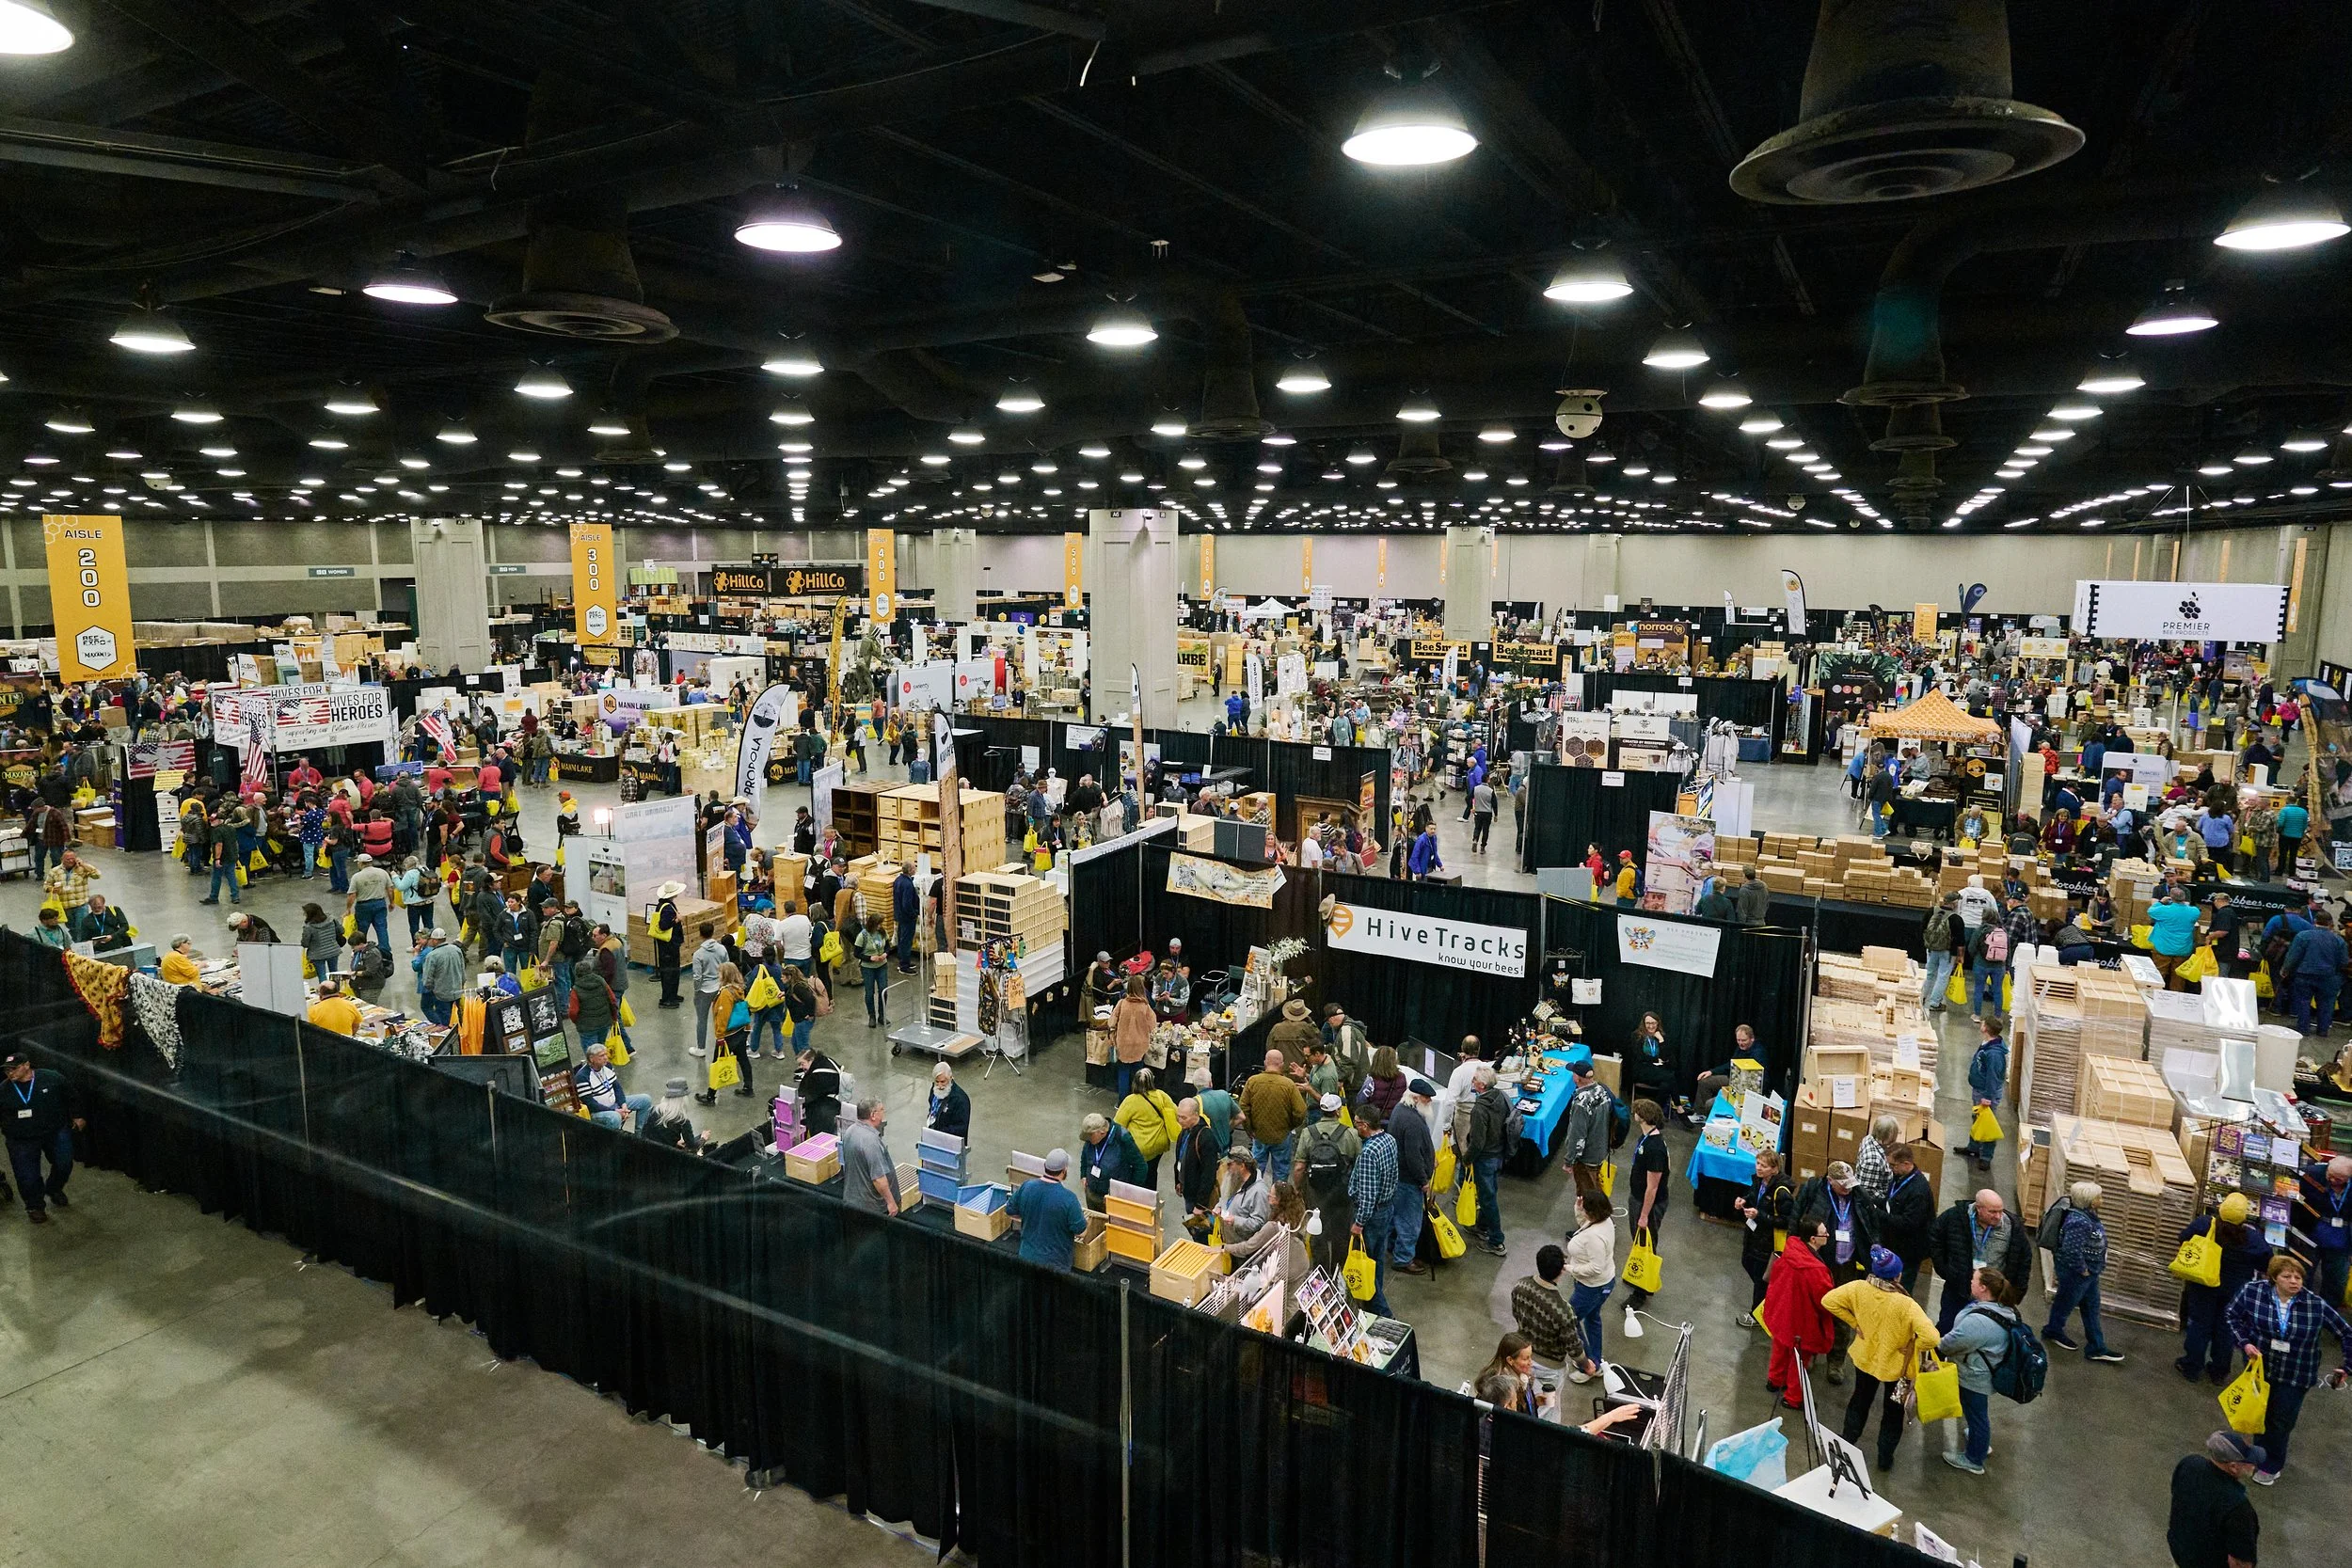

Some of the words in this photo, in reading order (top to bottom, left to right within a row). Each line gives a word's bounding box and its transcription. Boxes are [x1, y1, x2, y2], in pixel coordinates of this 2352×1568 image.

[65, 530, 103, 539] AISLE
[587, 547, 599, 591] 300
[78, 547, 102, 608] 200
[729, 574, 764, 588] HillCo
[805, 573, 845, 589] HillCo
[2163, 622, 2210, 630] PREMIER
[329, 695, 359, 707] HIVES
[362, 692, 382, 705] FOR
[331, 705, 383, 721] HEROES
[577, 764, 594, 774] LAKE
[743, 736, 763, 796] PROPOLA
[1367, 917, 1525, 959] HiveTracks
[1438, 952, 1467, 966] know
[1470, 959, 1493, 971] your
[1495, 961, 1524, 975] bees!
